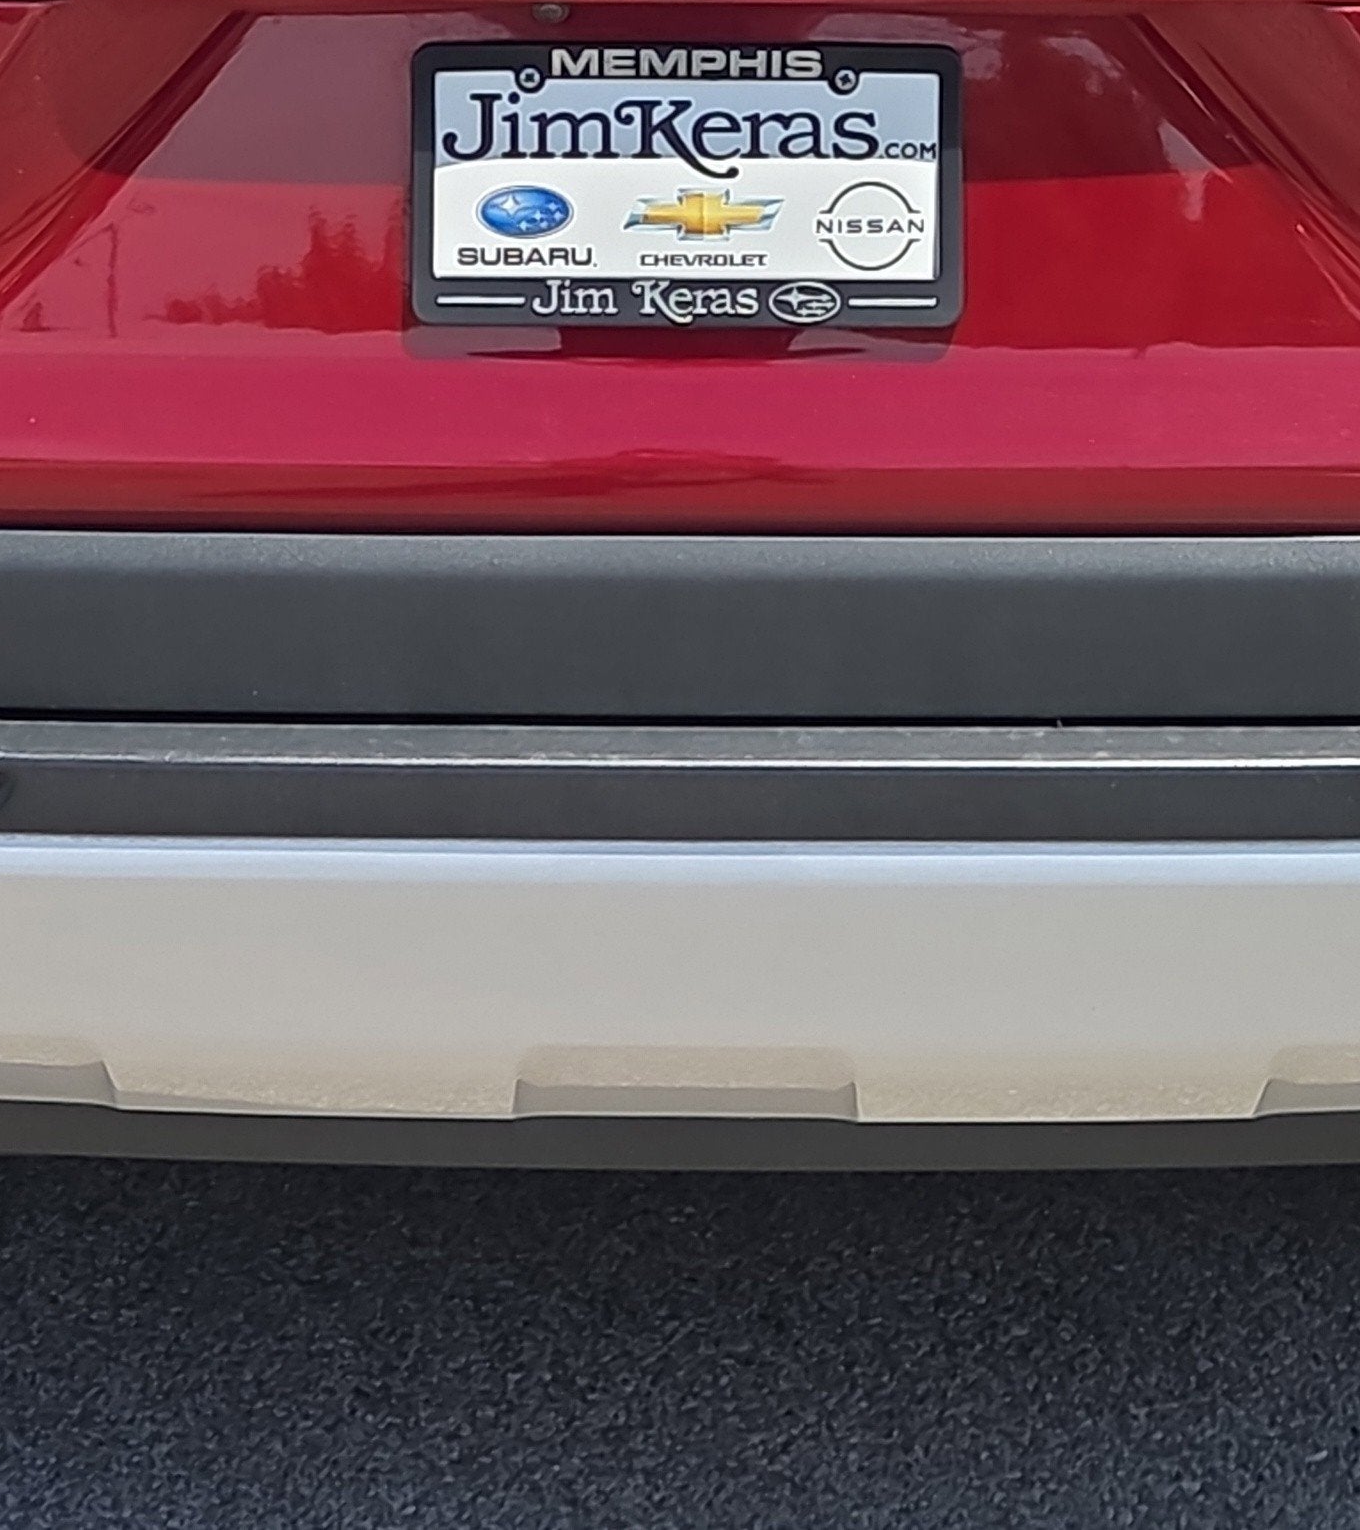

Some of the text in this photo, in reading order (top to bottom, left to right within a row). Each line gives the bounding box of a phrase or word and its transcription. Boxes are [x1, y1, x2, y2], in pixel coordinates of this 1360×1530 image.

[551, 48, 823, 78] MEMPHIS
[815, 219, 925, 234] NISSAN
[457, 247, 593, 267] SUBARU
[639, 254, 768, 267] CHEVROLET
[532, 280, 759, 324] Jim Keras
